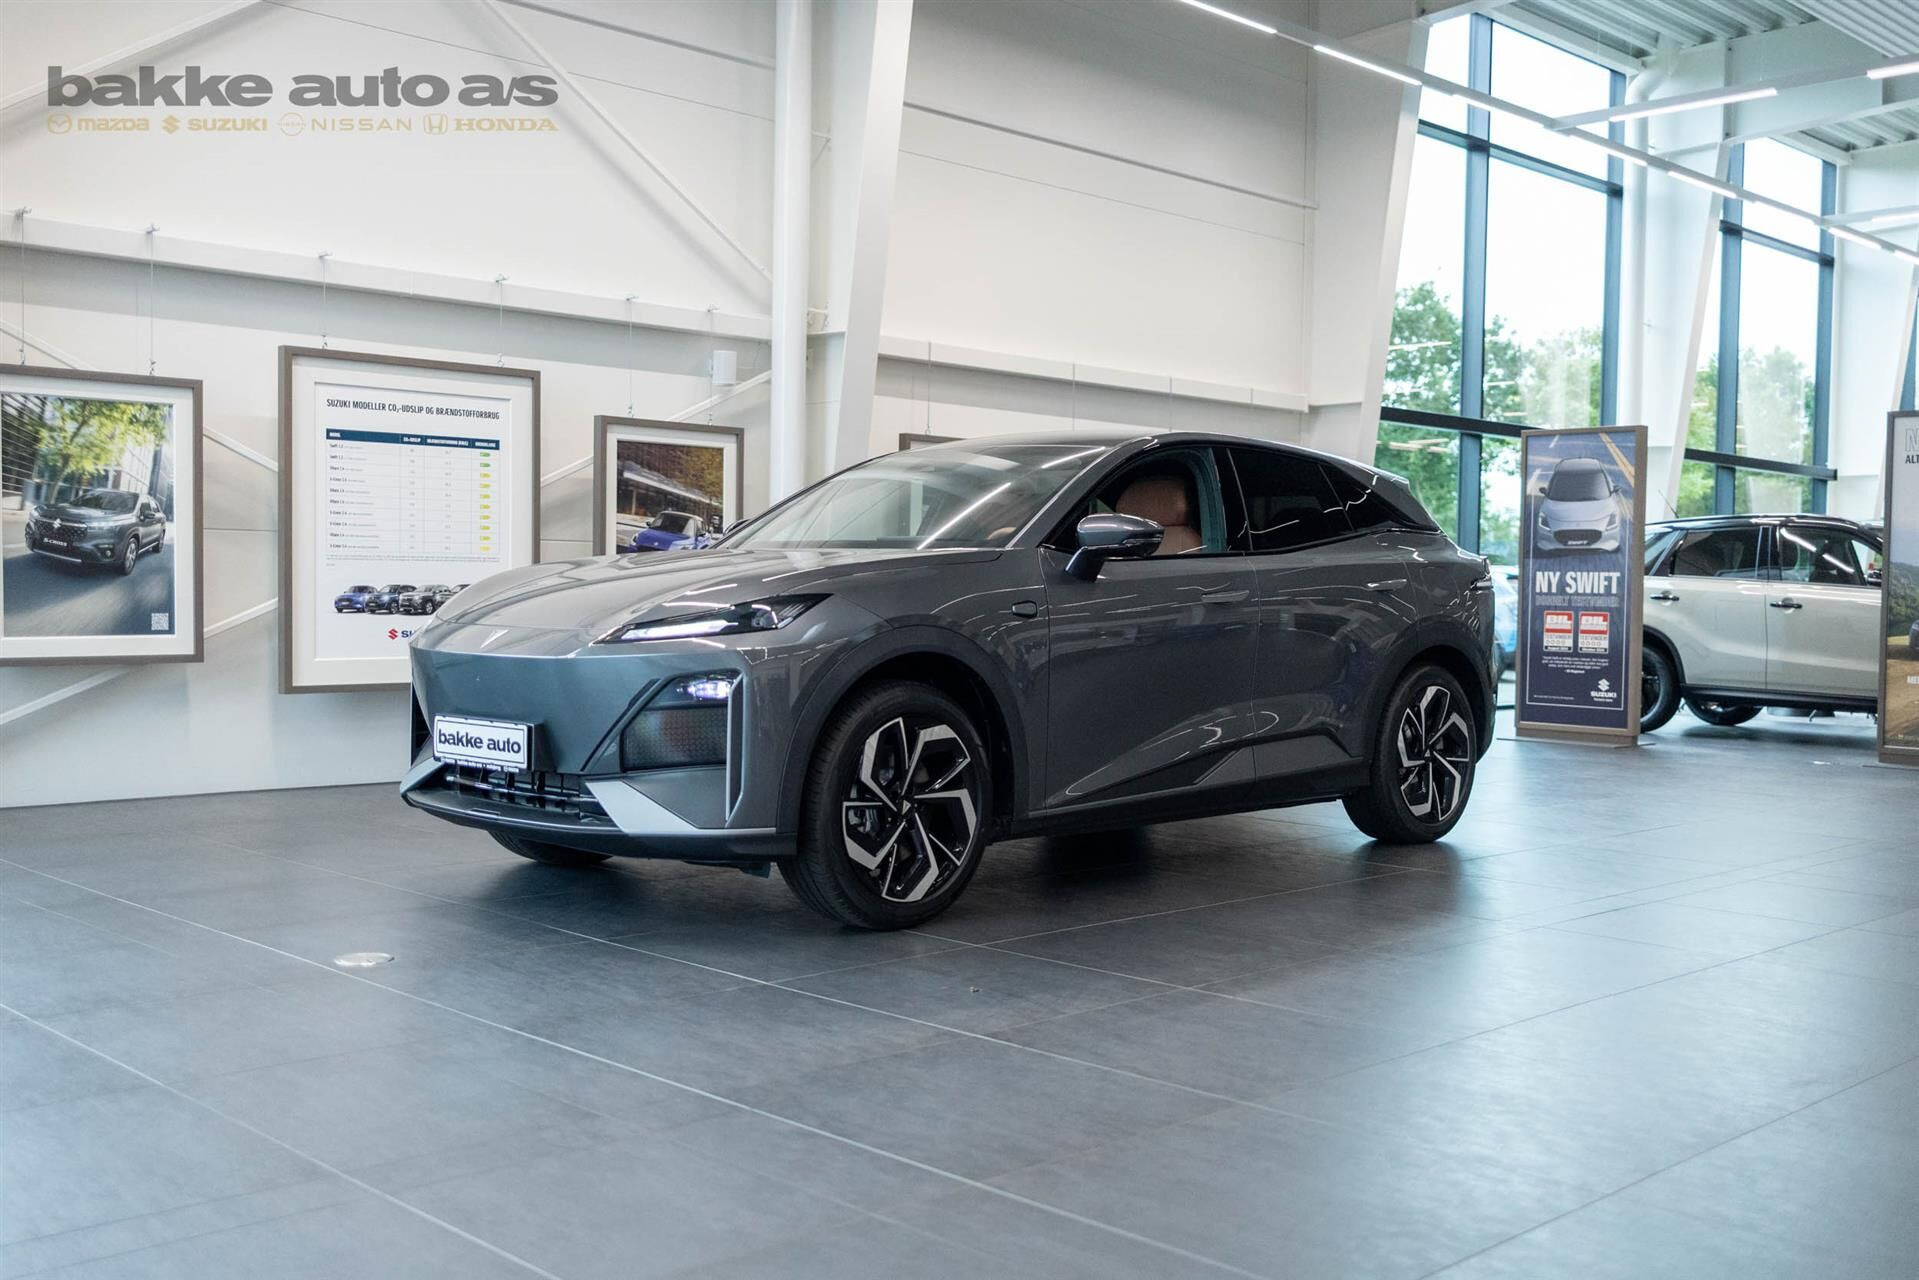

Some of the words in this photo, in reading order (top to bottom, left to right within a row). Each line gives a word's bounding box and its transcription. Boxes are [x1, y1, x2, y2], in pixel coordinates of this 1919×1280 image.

[326, 398, 351, 409] SUZUKI
[352, 401, 387, 412] MODELLER
[425, 406, 435, 415] OG
[435, 408, 500, 420] BRÆNDSTOFFORBRUG
[1535, 571, 1561, 593] NY
[1565, 571, 1621, 594] SWIFT
[438, 728, 484, 749] bakke
[487, 738, 522, 754] auto
